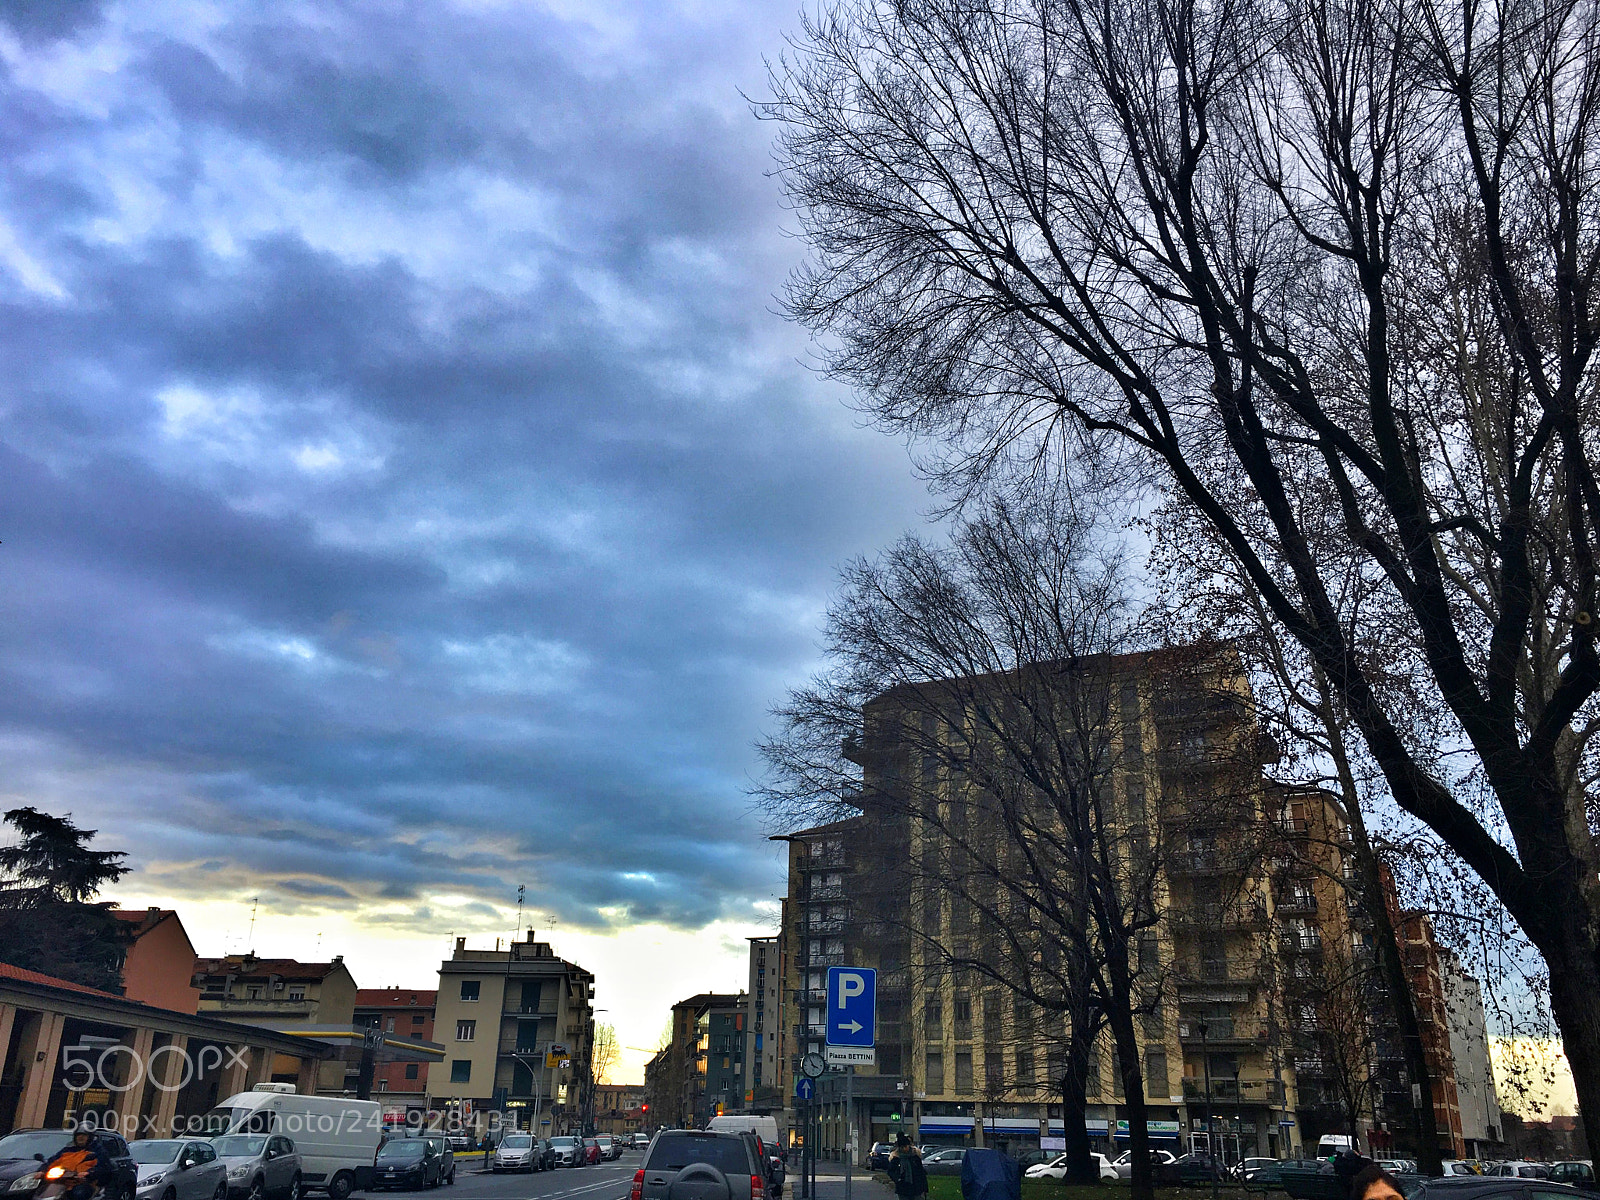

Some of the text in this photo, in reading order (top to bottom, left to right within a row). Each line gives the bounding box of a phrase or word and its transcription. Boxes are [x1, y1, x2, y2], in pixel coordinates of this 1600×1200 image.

[838, 972, 865, 1009] P
[829, 1052, 873, 1061] Piazza BETTINI
